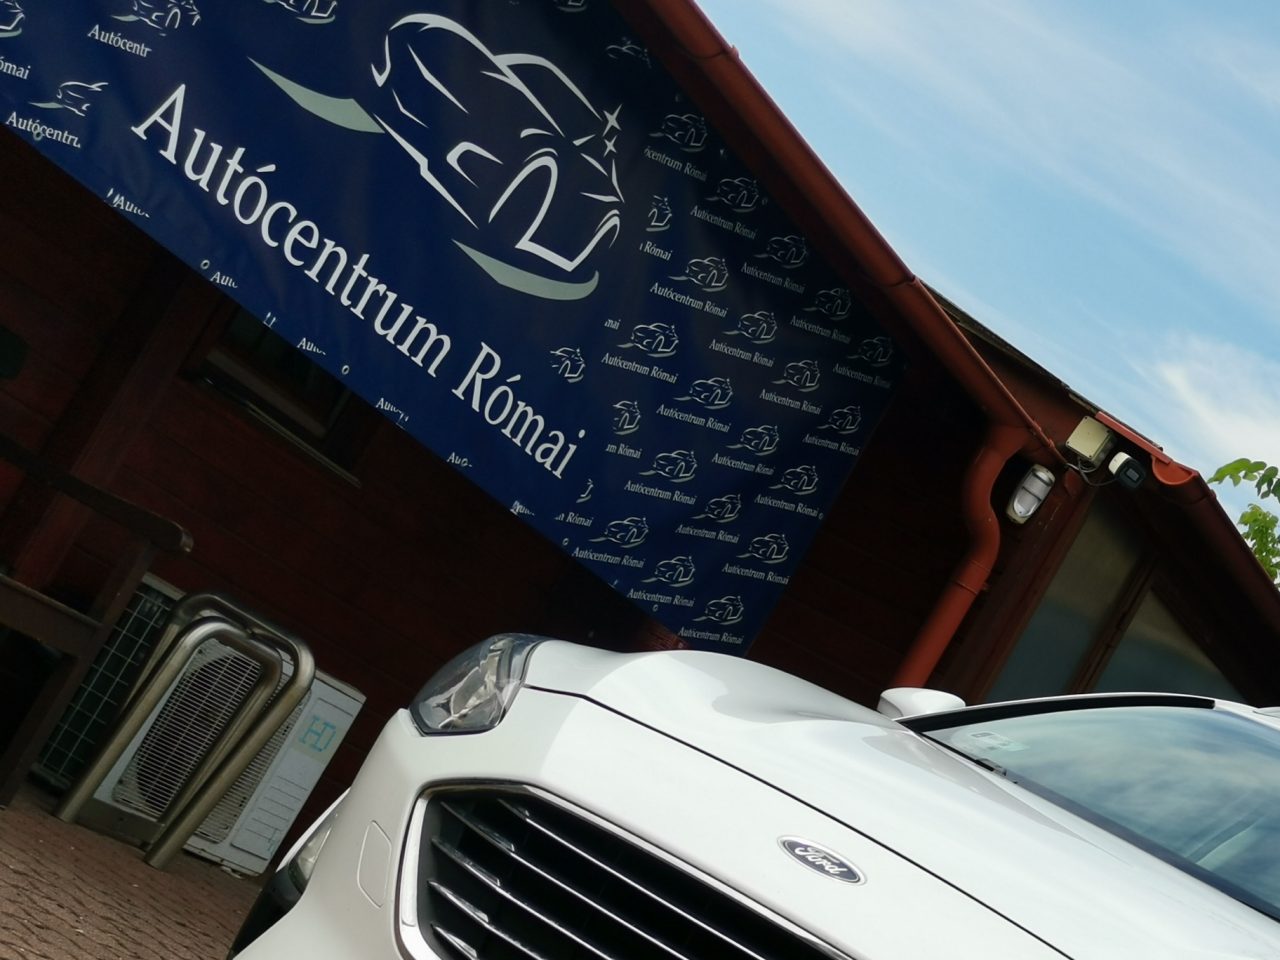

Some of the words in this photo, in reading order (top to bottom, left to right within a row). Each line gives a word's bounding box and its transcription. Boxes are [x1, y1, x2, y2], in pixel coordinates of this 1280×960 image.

[0, 56, 31, 80] ómai
[644, 241, 673, 261] Római
[130, 83, 452, 378] Autócentrum
[451, 341, 587, 480] Római
[650, 282, 703, 309] Autócentrum
[704, 302, 729, 318] Római
[601, 352, 650, 376] Autócentrum
[650, 366, 679, 384] Római
[656, 404, 705, 426] Autócentrum
[706, 417, 732, 433] Római
[617, 443, 643, 459] Római
[624, 480, 672, 501] Autócentrum
[672, 491, 698, 506] Római
[566, 512, 594, 527] Római
[716, 530, 741, 544] Római
[572, 547, 622, 566] Autócentrum
[794, 846, 848, 874] Ford
